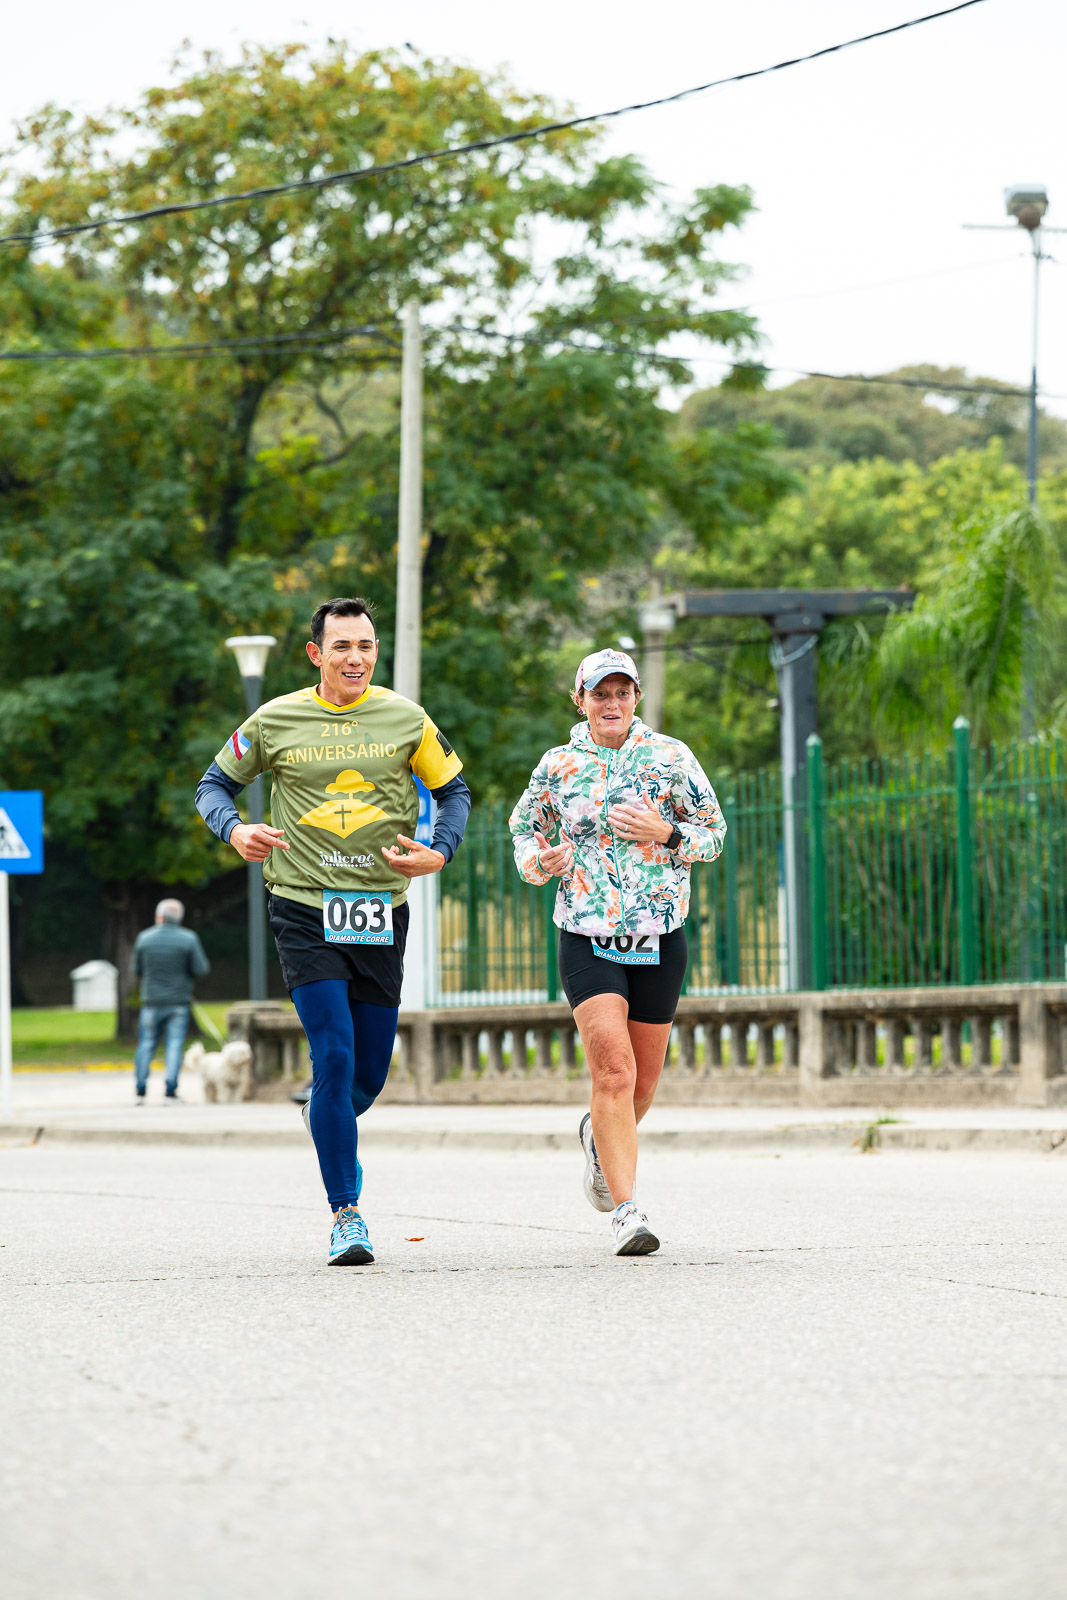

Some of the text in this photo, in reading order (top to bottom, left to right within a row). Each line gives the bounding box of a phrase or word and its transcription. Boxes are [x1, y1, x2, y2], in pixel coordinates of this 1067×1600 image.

[286, 743, 397, 764] ANIVERSARIO
[327, 896, 386, 934] 063
[328, 934, 365, 943] DIAMANTE
[596, 949, 630, 963] DIAMANTE
